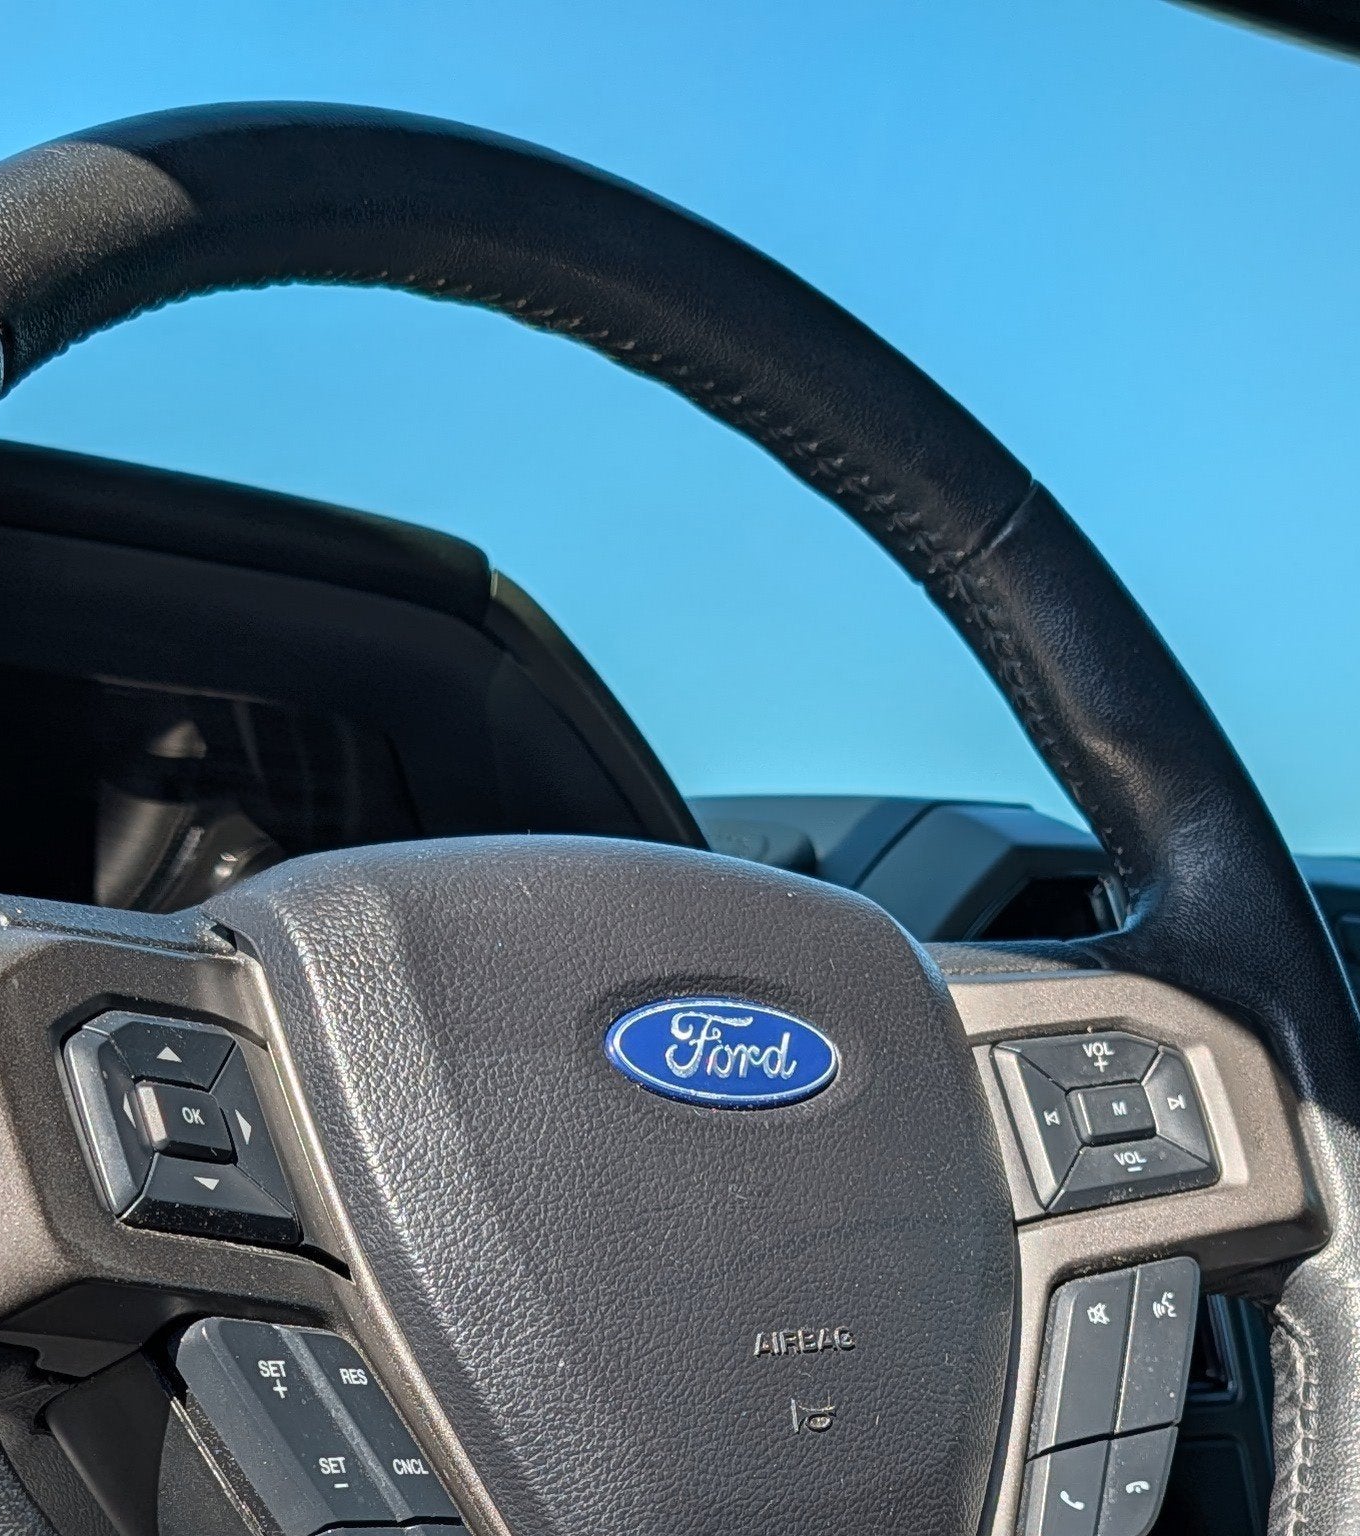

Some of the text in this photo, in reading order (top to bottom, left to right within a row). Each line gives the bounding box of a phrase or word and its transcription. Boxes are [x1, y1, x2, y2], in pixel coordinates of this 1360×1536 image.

[665, 1011, 797, 1080] Ford
[1082, 1041, 1115, 1058] VOL
[181, 1106, 206, 1126] OK
[1112, 1101, 1127, 1116] M
[1113, 1150, 1147, 1166] VOL
[753, 1325, 855, 1357] AIRBAG
[257, 1360, 287, 1378] SET
[339, 1367, 368, 1386] RES
[318, 1456, 347, 1474] SET
[392, 1458, 429, 1476] CNCL
